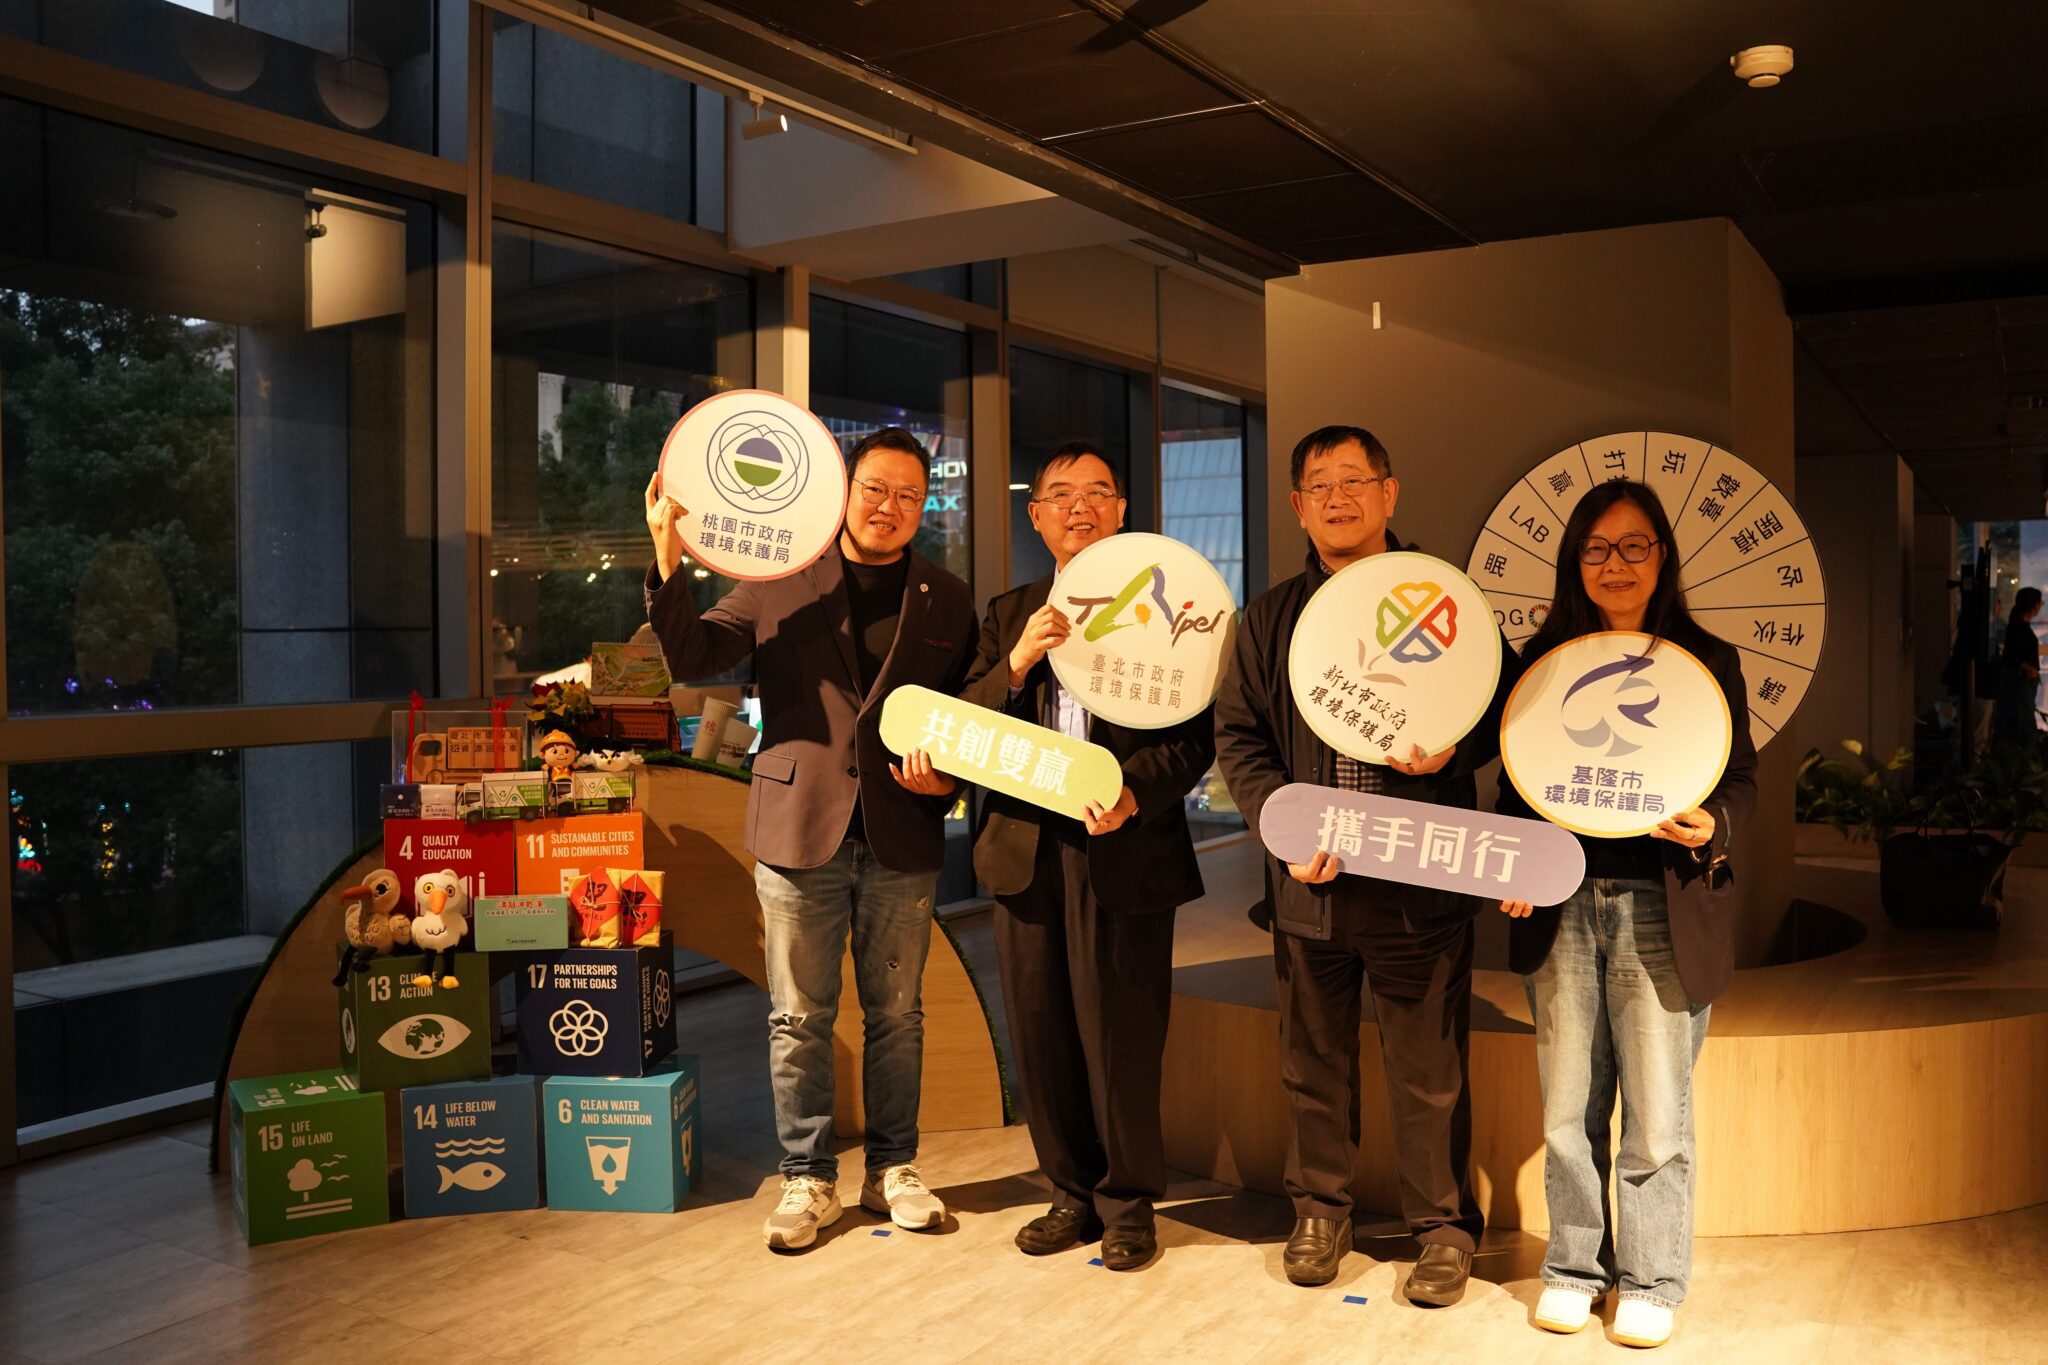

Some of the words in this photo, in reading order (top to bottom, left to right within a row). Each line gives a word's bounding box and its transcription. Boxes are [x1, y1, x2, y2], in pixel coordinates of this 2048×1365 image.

[1662, 450, 1686, 474] 玩
[1698, 472, 1741, 523] 歡喜
[702, 512, 793, 546] 桃園市政府
[1509, 505, 1550, 544] LAB
[699, 532, 790, 564] 環境保護局
[1484, 552, 1508, 578] 眠
[1777, 564, 1804, 588] 吃
[1752, 619, 1804, 647] 作伙
[1092, 654, 1184, 687] 臺北市政府
[1089, 676, 1181, 709] 環境保護局
[1323, 665, 1407, 731] 新北市政府
[1758, 677, 1787, 706] 講
[1309, 686, 1396, 751] 環境保護局
[917, 708, 1074, 796] 共創雙贏
[1571, 765, 1644, 789] 基隆市
[1544, 784, 1665, 815] 環境保護局
[399, 835, 414, 861] 4
[422, 834, 459, 848] QUALITY
[526, 833, 545, 859] 11
[550, 832, 606, 845] SUSTAINABLE
[608, 831, 635, 842] CITIES
[551, 846, 569, 858] AND
[570, 844, 630, 857] COMMUNITIES
[1315, 805, 1521, 883] 攜手同行
[422, 848, 472, 860] EDUCATION
[399, 971, 438, 985] CLIE
[527, 963, 548, 989] 17
[553, 963, 618, 976] PARTNERSHIPS
[367, 975, 391, 1002] 13
[400, 985, 433, 999] ACTION
[554, 978, 572, 989] FOR
[573, 978, 588, 989] THE
[589, 978, 617, 990] GOALS
[413, 1104, 438, 1130] 14
[445, 1102, 464, 1114] LIFE
[465, 1100, 496, 1113] BELOW
[558, 1098, 572, 1124] 6
[580, 1099, 608, 1111] CLEAN
[610, 1099, 640, 1112] WATER
[291, 1120, 311, 1133] LIFE
[446, 1115, 476, 1128] WATER
[581, 1113, 600, 1125] AND
[601, 1113, 652, 1126] SANITATION
[258, 1123, 284, 1152] 15
[292, 1135, 306, 1148] ON
[308, 1132, 333, 1146] LAND
